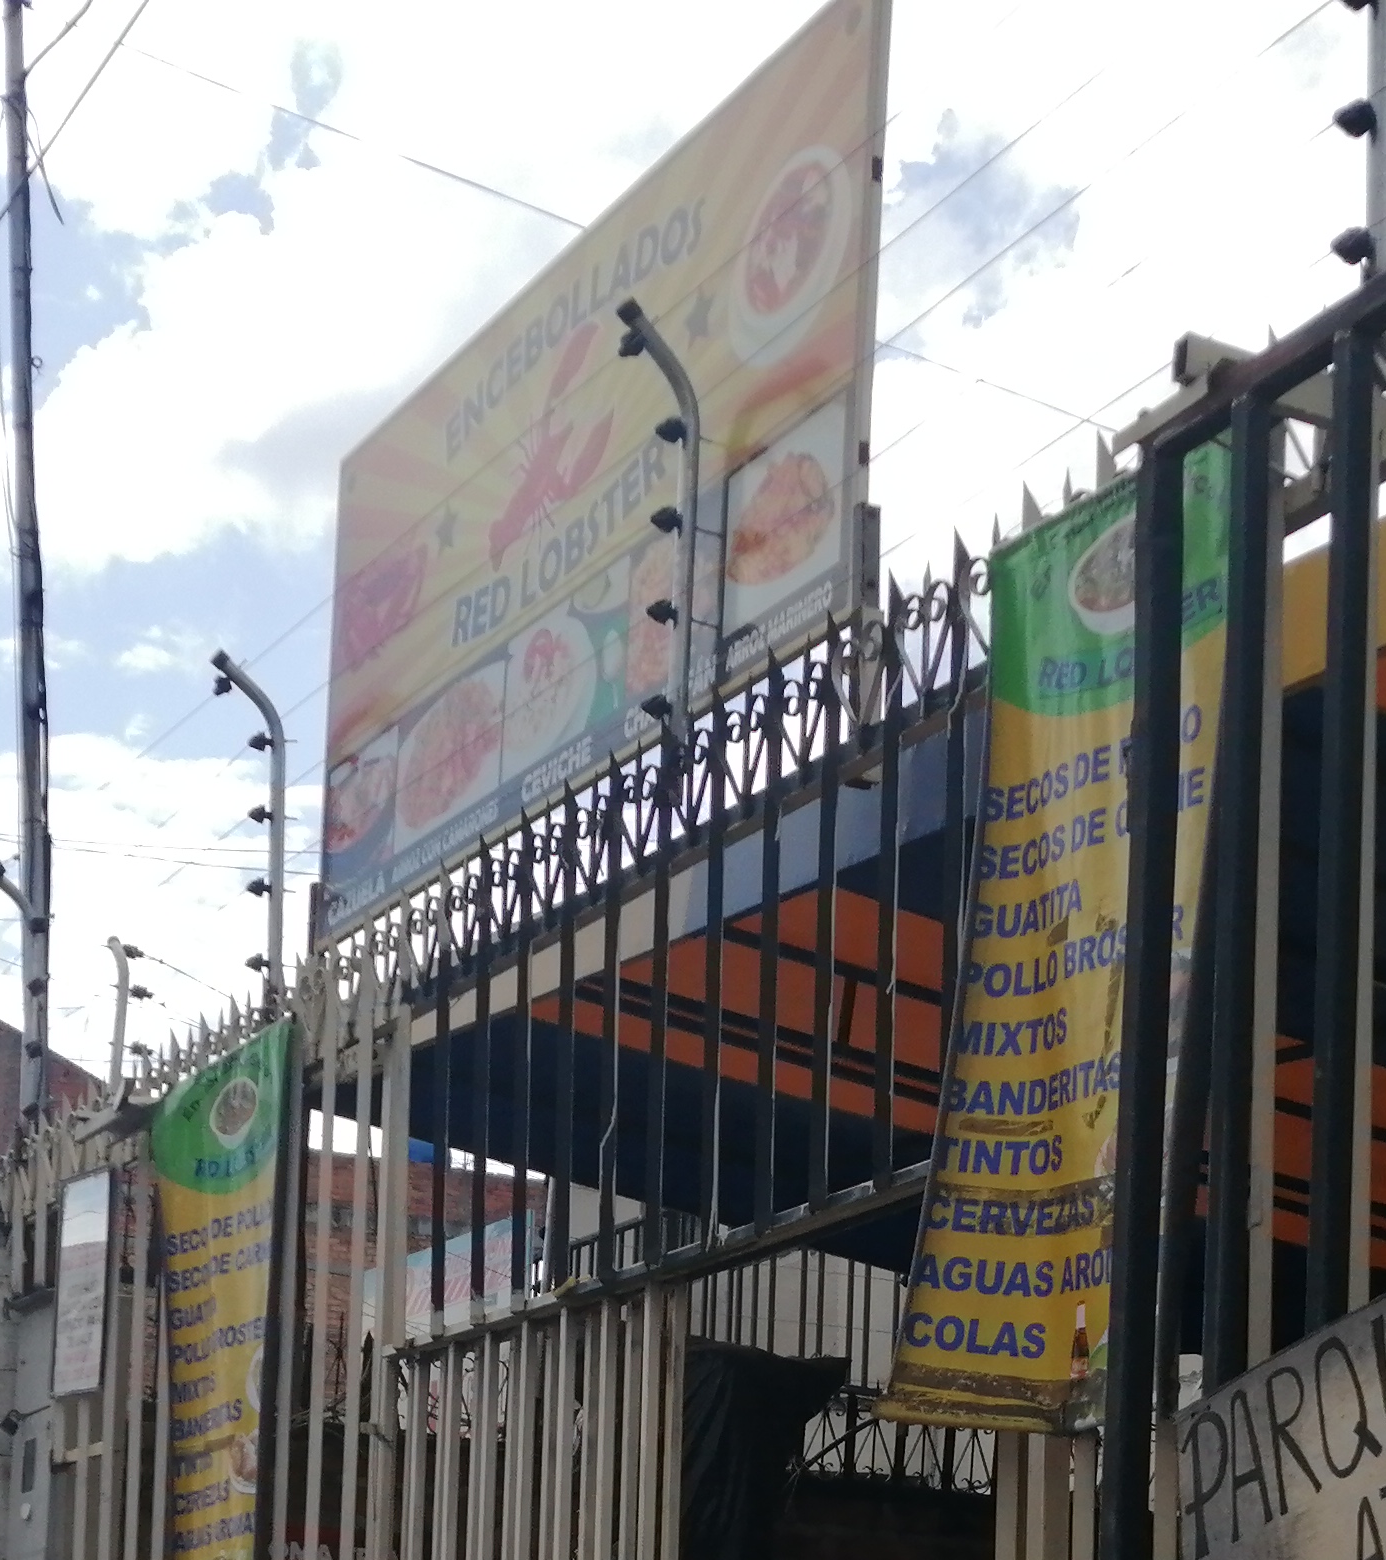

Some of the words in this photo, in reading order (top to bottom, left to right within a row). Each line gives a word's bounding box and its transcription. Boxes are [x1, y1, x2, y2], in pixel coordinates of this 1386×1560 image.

[444, 195, 706, 464] ENCEBOLLADOS
[451, 575, 511, 648] RED
[520, 437, 666, 608] LOBSTER
[1038, 655, 1087, 691] RED
[521, 735, 593, 801] CEVICHE
[985, 762, 1069, 823] SECOS
[1073, 744, 1112, 791] DE
[977, 824, 1066, 881] SECOS
[1071, 808, 1107, 854] DE
[972, 878, 1082, 940] GUATITA
[965, 947, 1057, 999] POLLO
[956, 1007, 1067, 1057] MIXTOS
[946, 1051, 1120, 1116] BANDERITAS
[935, 1135, 1062, 1176] TINTOS
[211, 1215, 233, 1239] DE
[924, 1189, 1094, 1236] CERVEZAS
[915, 1254, 1054, 1299] AGUAS
[904, 1312, 1046, 1359] COLAS
